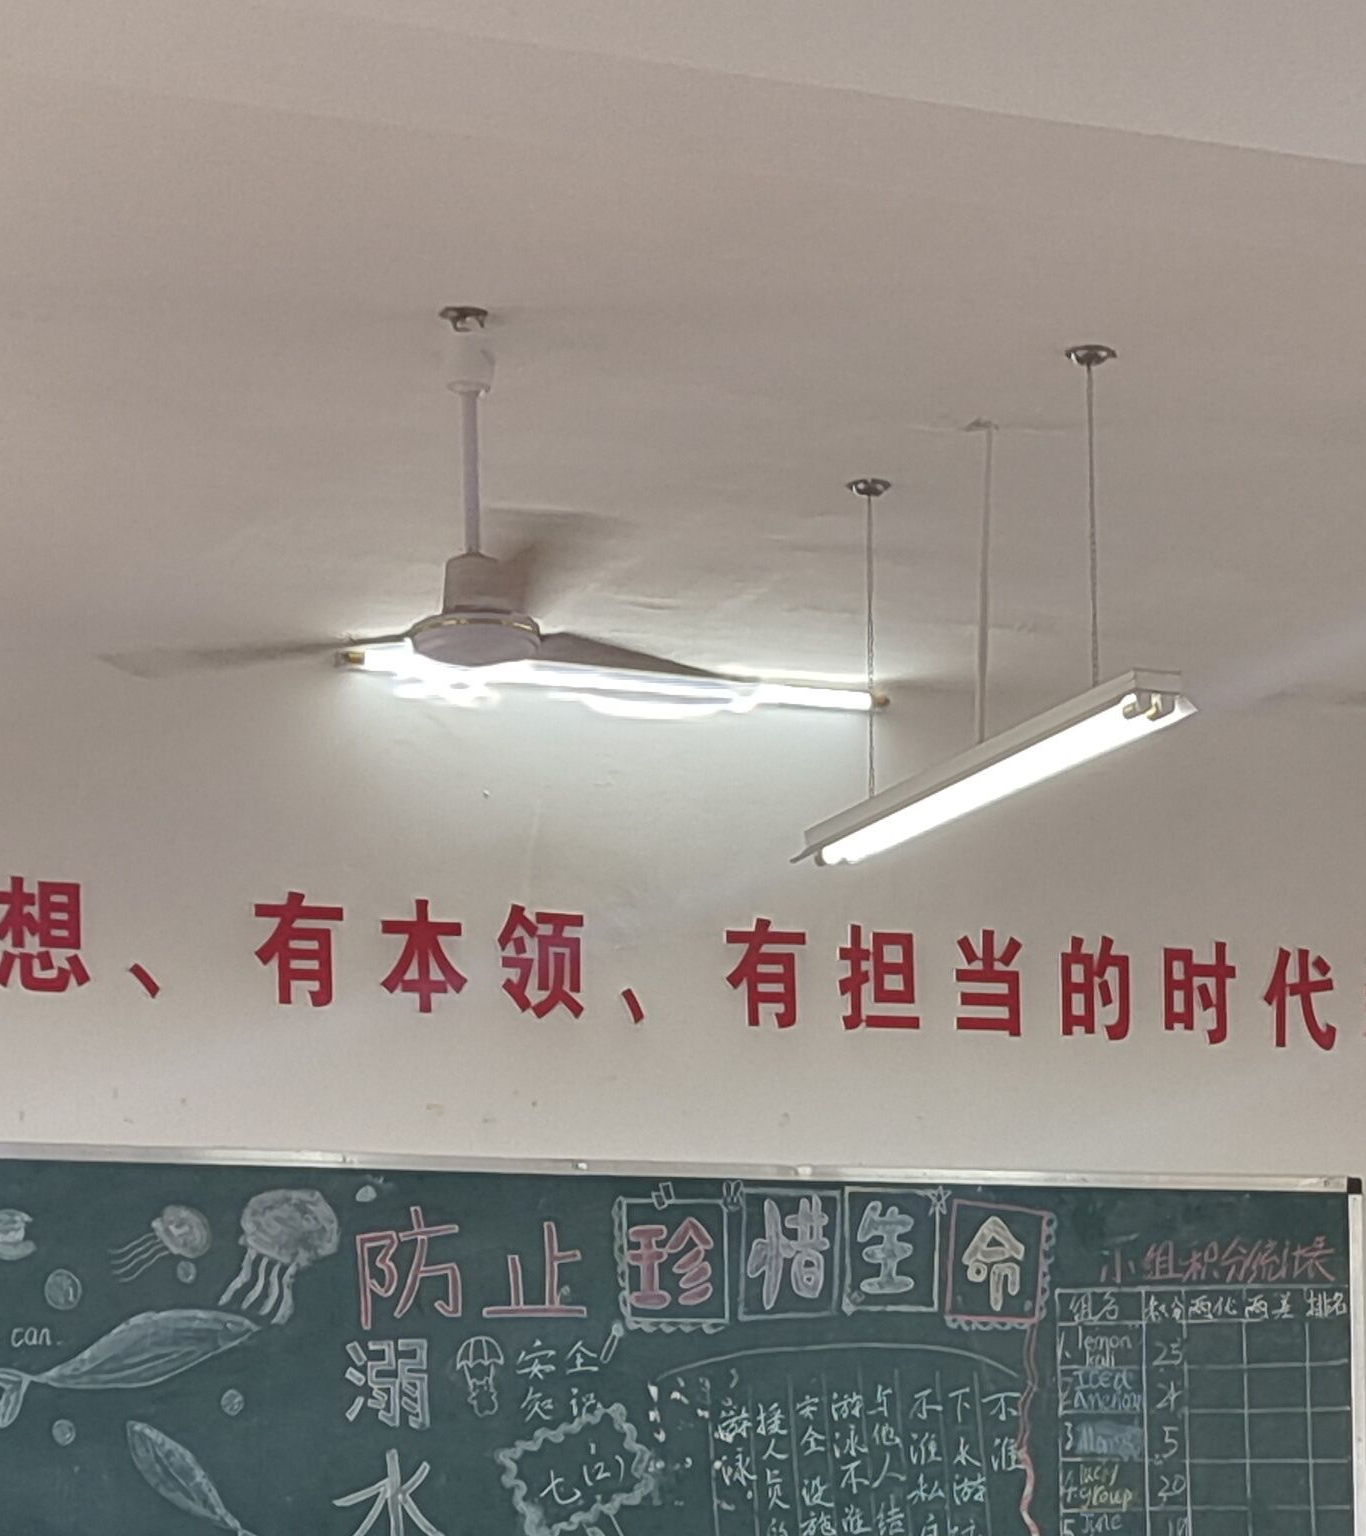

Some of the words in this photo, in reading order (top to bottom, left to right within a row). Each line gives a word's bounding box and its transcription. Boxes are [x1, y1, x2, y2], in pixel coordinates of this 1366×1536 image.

[356, 1206, 587, 1329] 防止
[627, 1197, 1026, 1311] 珍惜生命
[516, 1339, 599, 1380] 安全
[520, 1386, 603, 1423] 知识
[1161, 1425, 1180, 1459] 5
[1079, 1485, 1133, 1512] group
